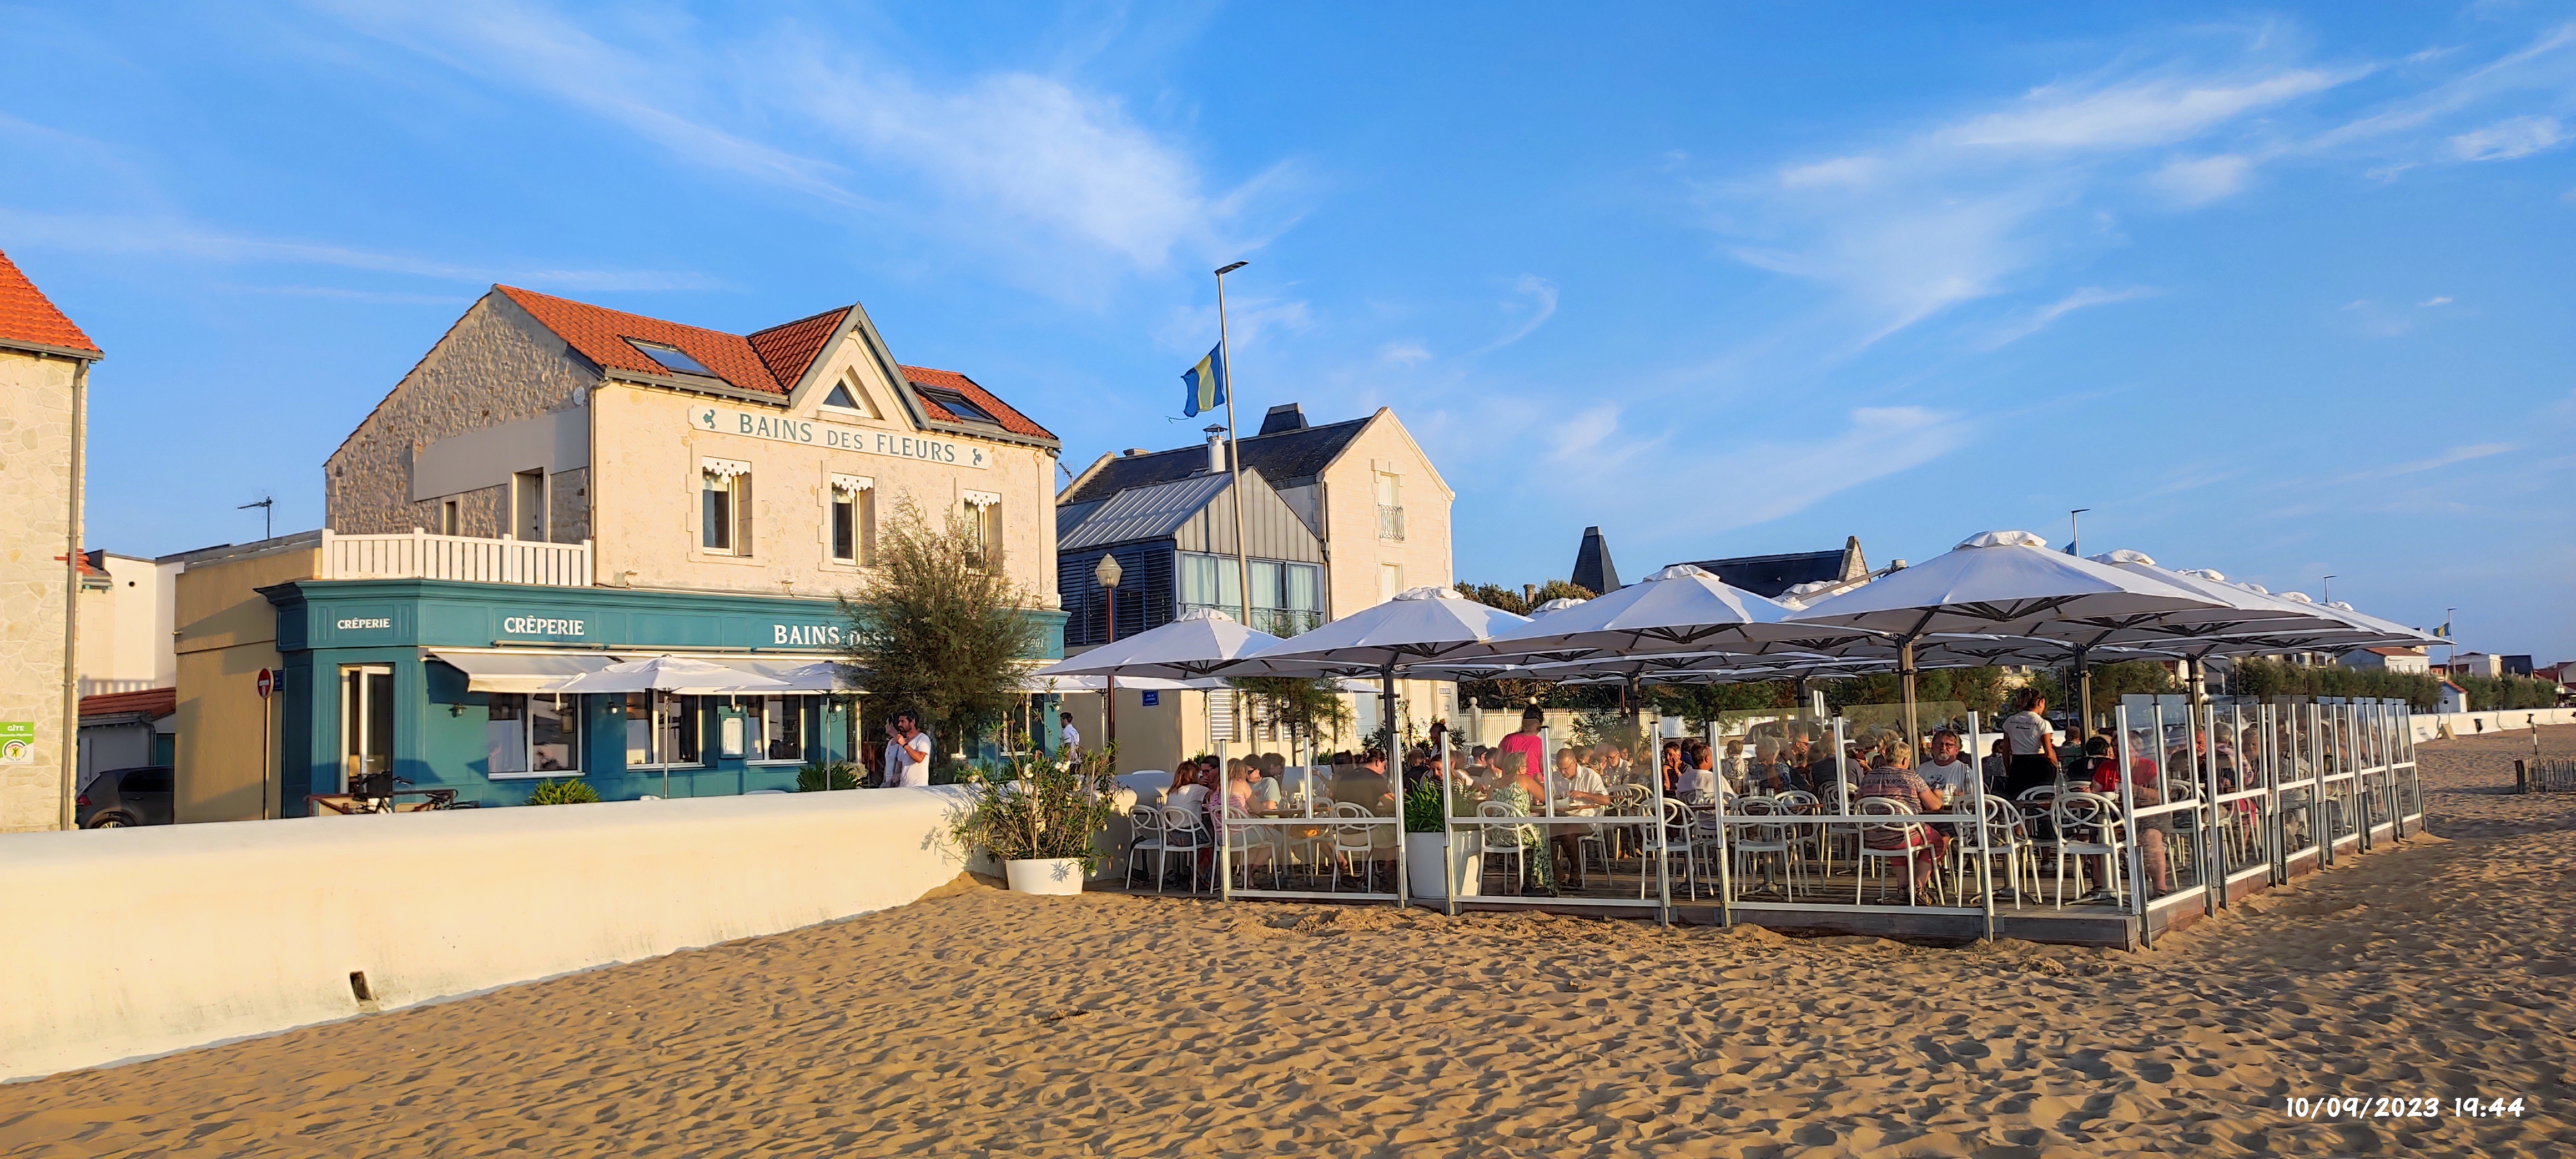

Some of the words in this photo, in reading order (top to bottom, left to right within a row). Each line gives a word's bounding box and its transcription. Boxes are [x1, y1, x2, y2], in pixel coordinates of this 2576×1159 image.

[739, 413, 812, 442] BAINS
[827, 430, 863, 450] DES
[876, 433, 955, 462] FLEURS
[337, 617, 390, 629] CRÊPERIE
[504, 614, 585, 636] CRÊPERIE
[773, 624, 839, 645] BAINS
